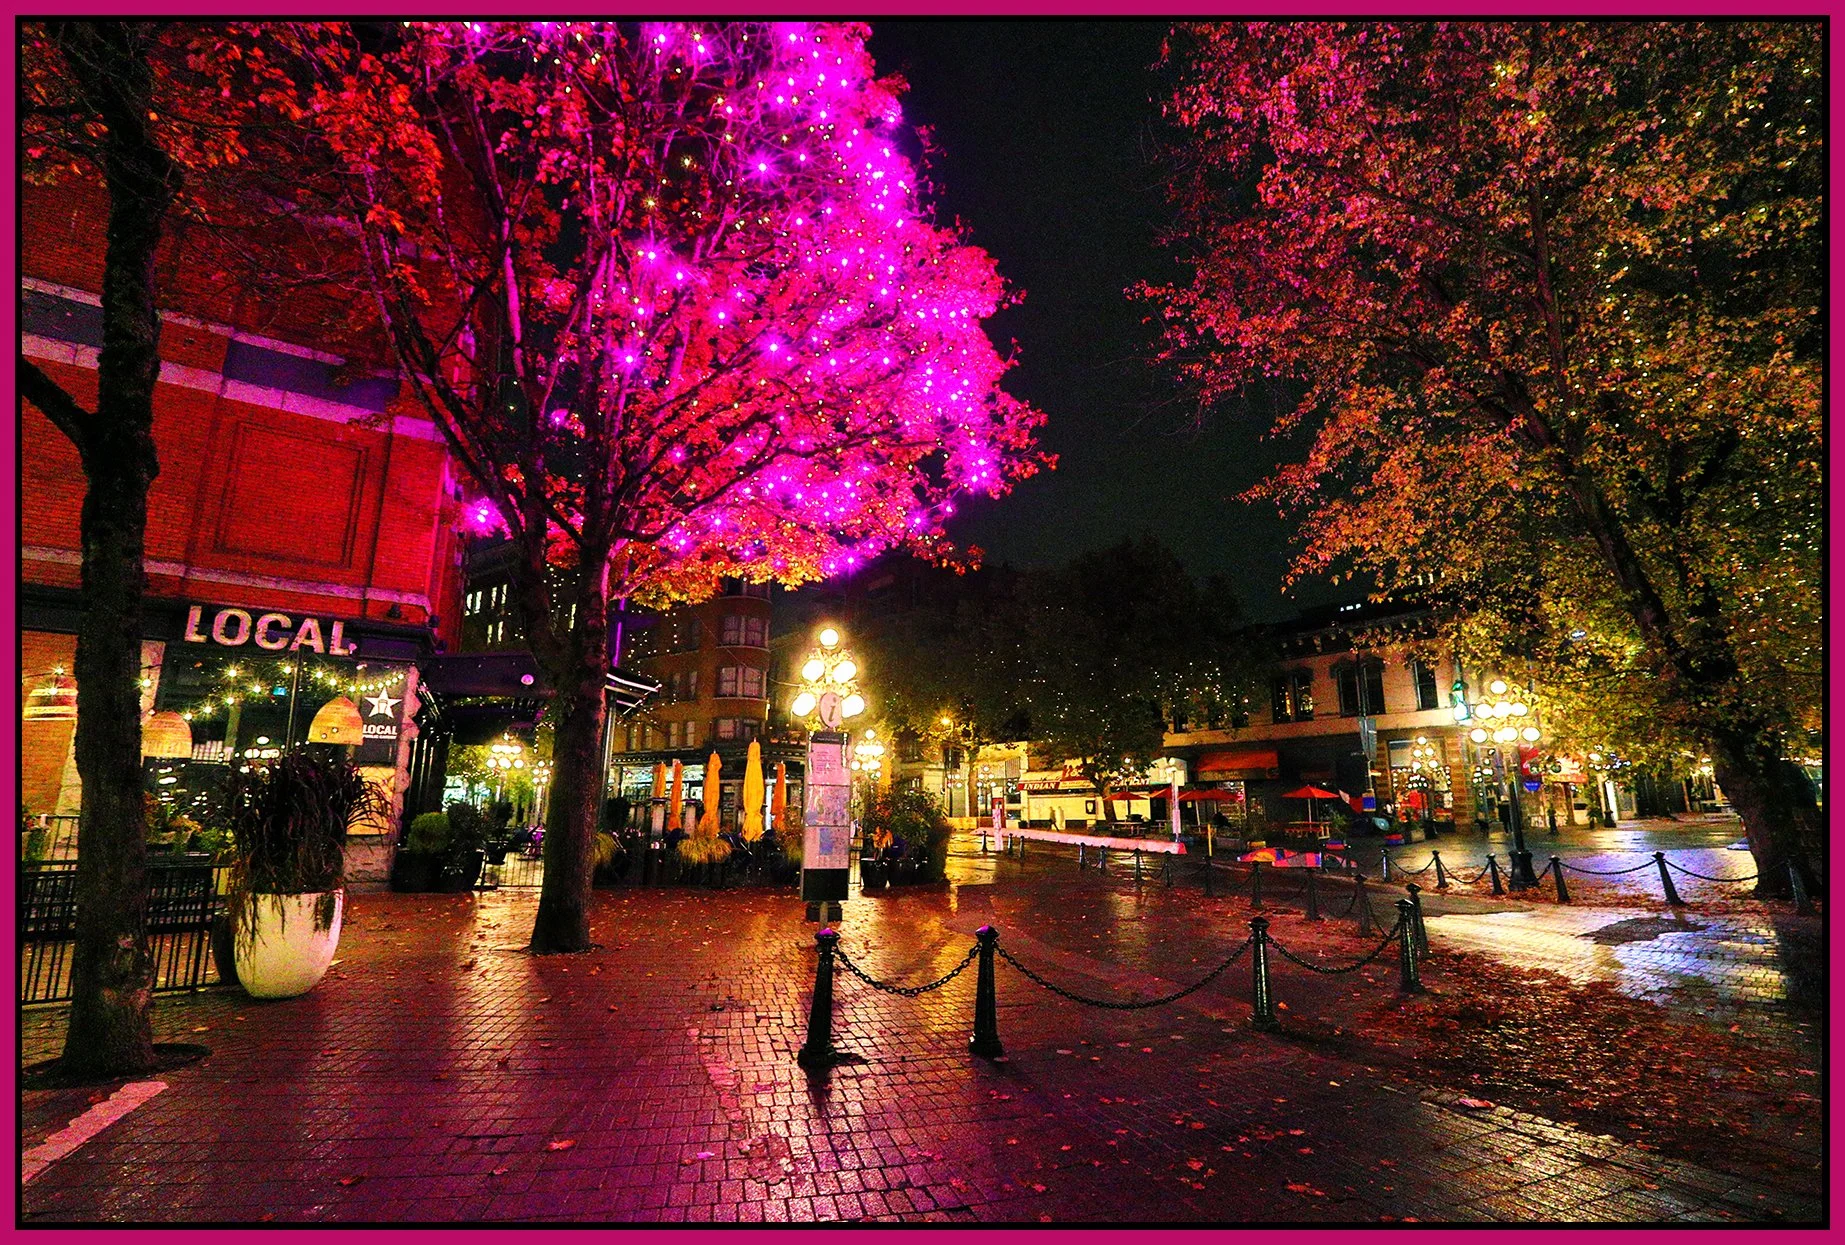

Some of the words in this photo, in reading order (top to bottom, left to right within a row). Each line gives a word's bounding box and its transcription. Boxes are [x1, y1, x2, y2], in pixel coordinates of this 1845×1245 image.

[184, 605, 350, 656] LOCAL
[362, 724, 398, 735] LOCAL
[1023, 782, 1056, 790] INDIAN
